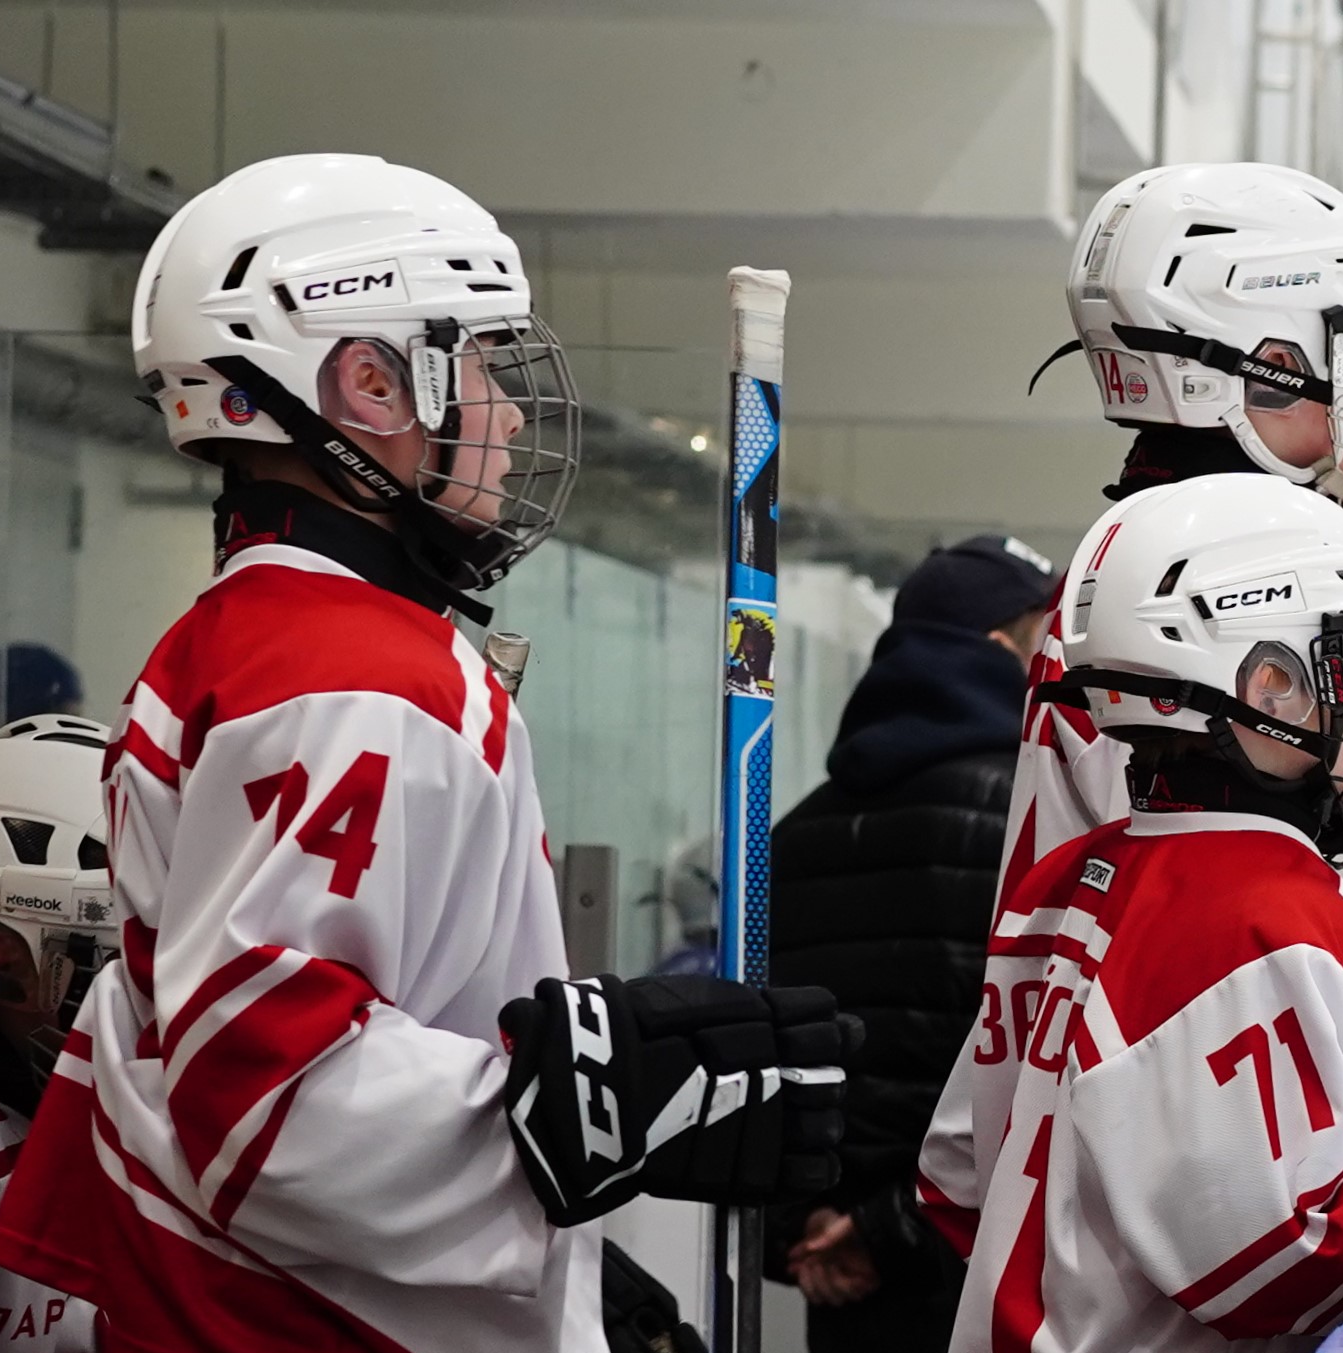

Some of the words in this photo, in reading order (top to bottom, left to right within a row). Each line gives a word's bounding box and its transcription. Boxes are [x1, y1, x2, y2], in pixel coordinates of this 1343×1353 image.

[303, 271, 394, 301] CCM
[1242, 272, 1322, 291] BAUER
[1098, 352, 1125, 405] 14
[1240, 360, 1306, 389] BAUER
[323, 440, 402, 500] BAUER
[1215, 584, 1293, 611] CCM
[1255, 723, 1303, 746] CCM
[243, 750, 390, 900] 74
[1205, 1007, 1336, 1162] 71
